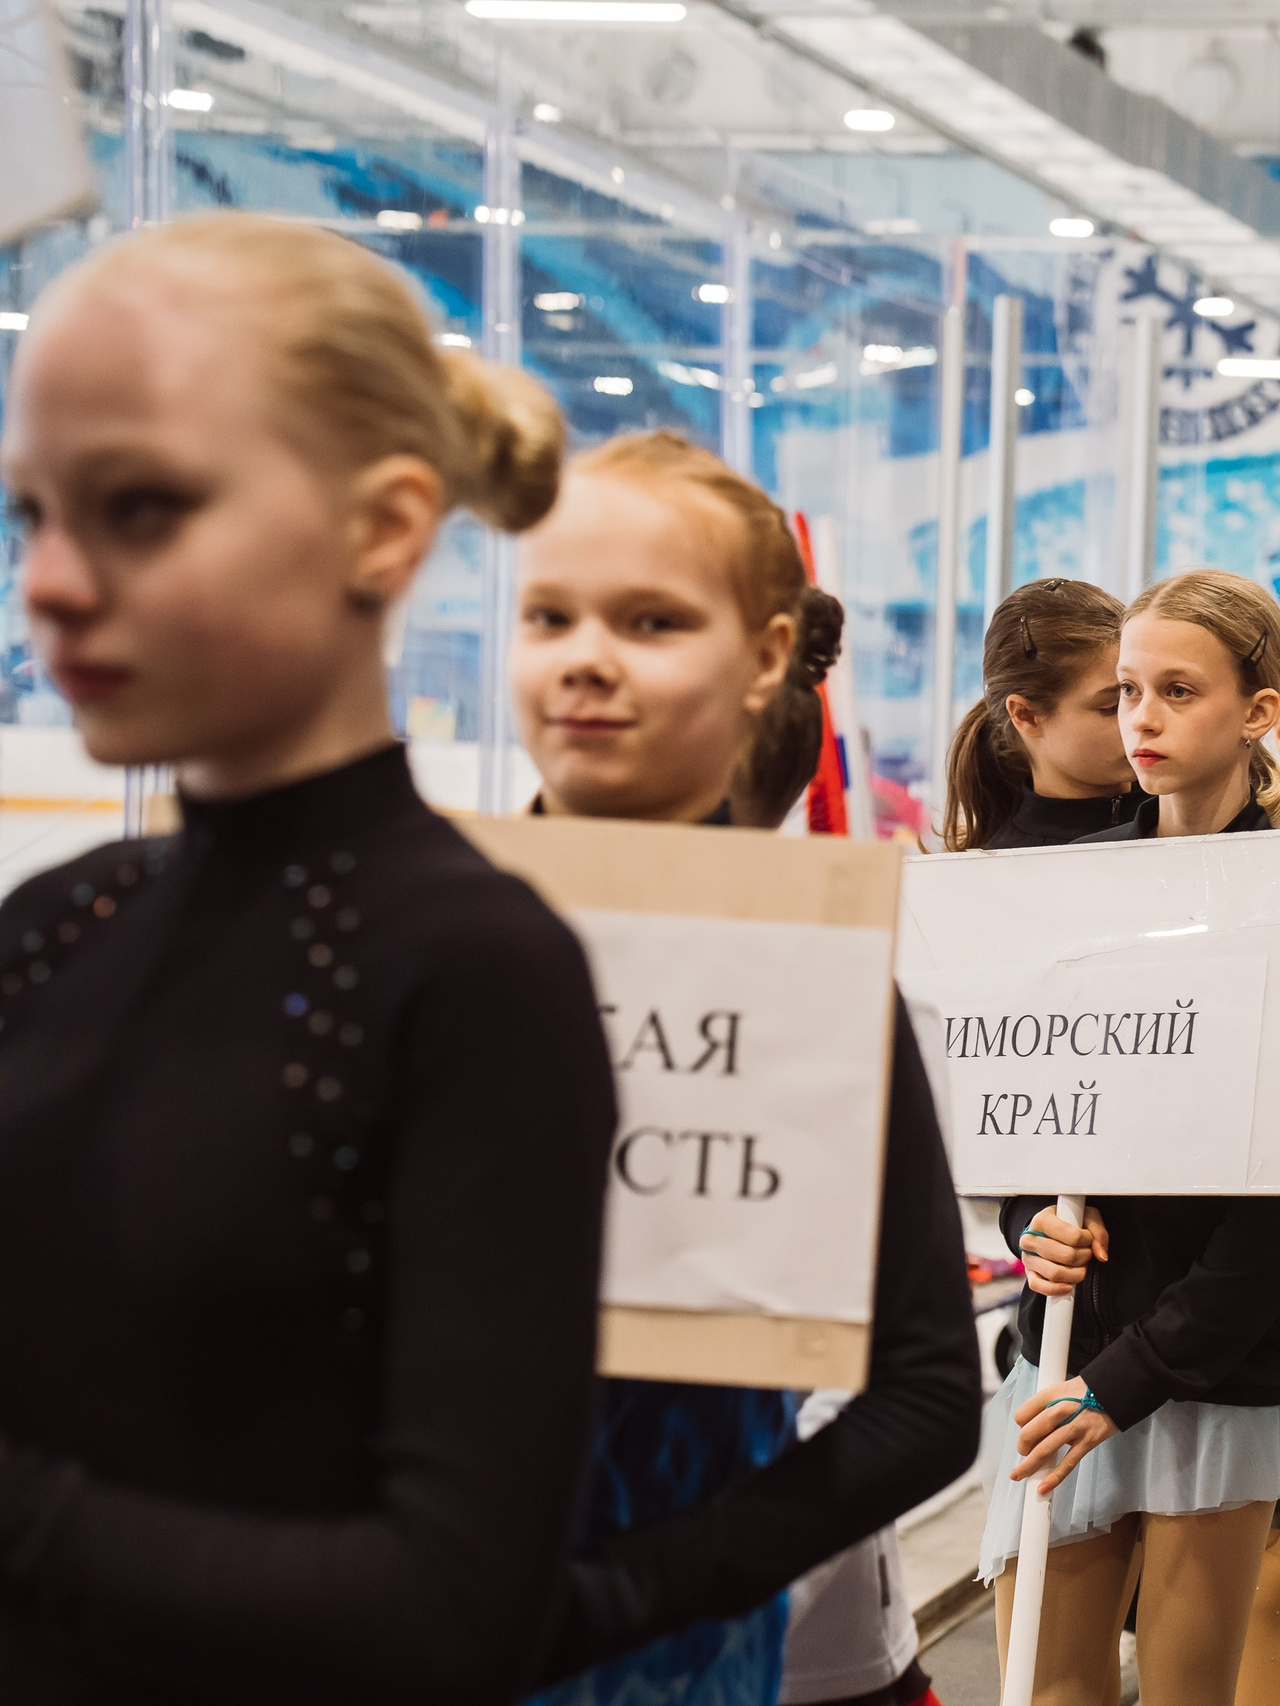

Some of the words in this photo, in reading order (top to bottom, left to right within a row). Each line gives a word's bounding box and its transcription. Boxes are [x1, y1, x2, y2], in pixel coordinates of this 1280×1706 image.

[601, 1004, 743, 1077] АЯ
[945, 998, 1199, 1058] ИМОРСКИЙ
[976, 1079, 1101, 1136] КРАЙ
